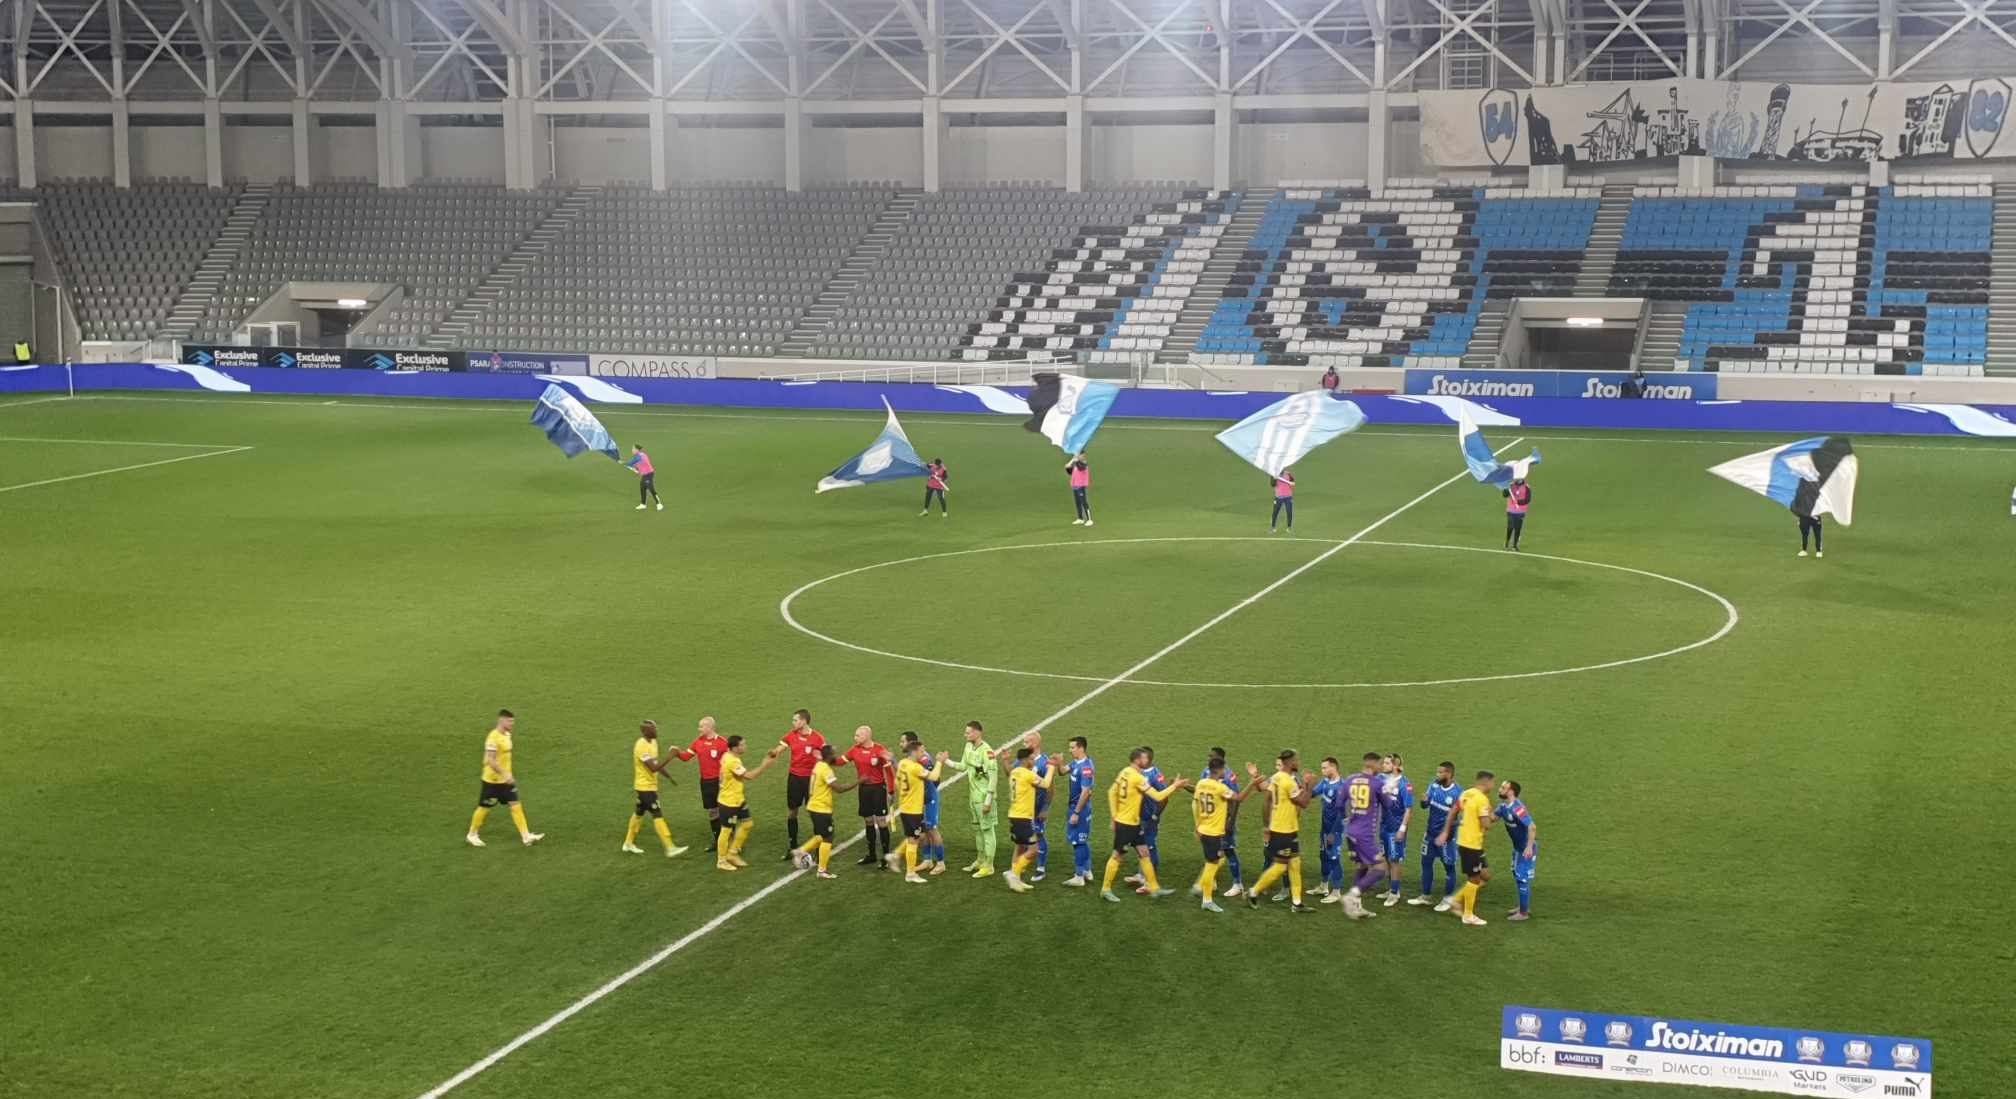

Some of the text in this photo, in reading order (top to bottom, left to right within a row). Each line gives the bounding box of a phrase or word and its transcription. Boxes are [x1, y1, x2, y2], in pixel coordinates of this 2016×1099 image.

[214, 350, 258, 360] Exclusive
[296, 352, 341, 362] Exclusive
[396, 353, 449, 364] Exclusive
[598, 360, 691, 378] COMPASS
[1427, 375, 1534, 397] Stoiximan
[1582, 378, 1692, 400] Stoiman
[1349, 784, 1371, 810] 99
[1645, 1021, 1784, 1058] Stoiximan
[1508, 1044, 1545, 1064] bbf:
[1558, 1053, 1600, 1064] LAMBERTS
[1662, 1062, 1710, 1076] DIMCO
[1722, 1066, 1778, 1078] COLUMBIA
[1884, 1085, 1916, 1096] PUMA
